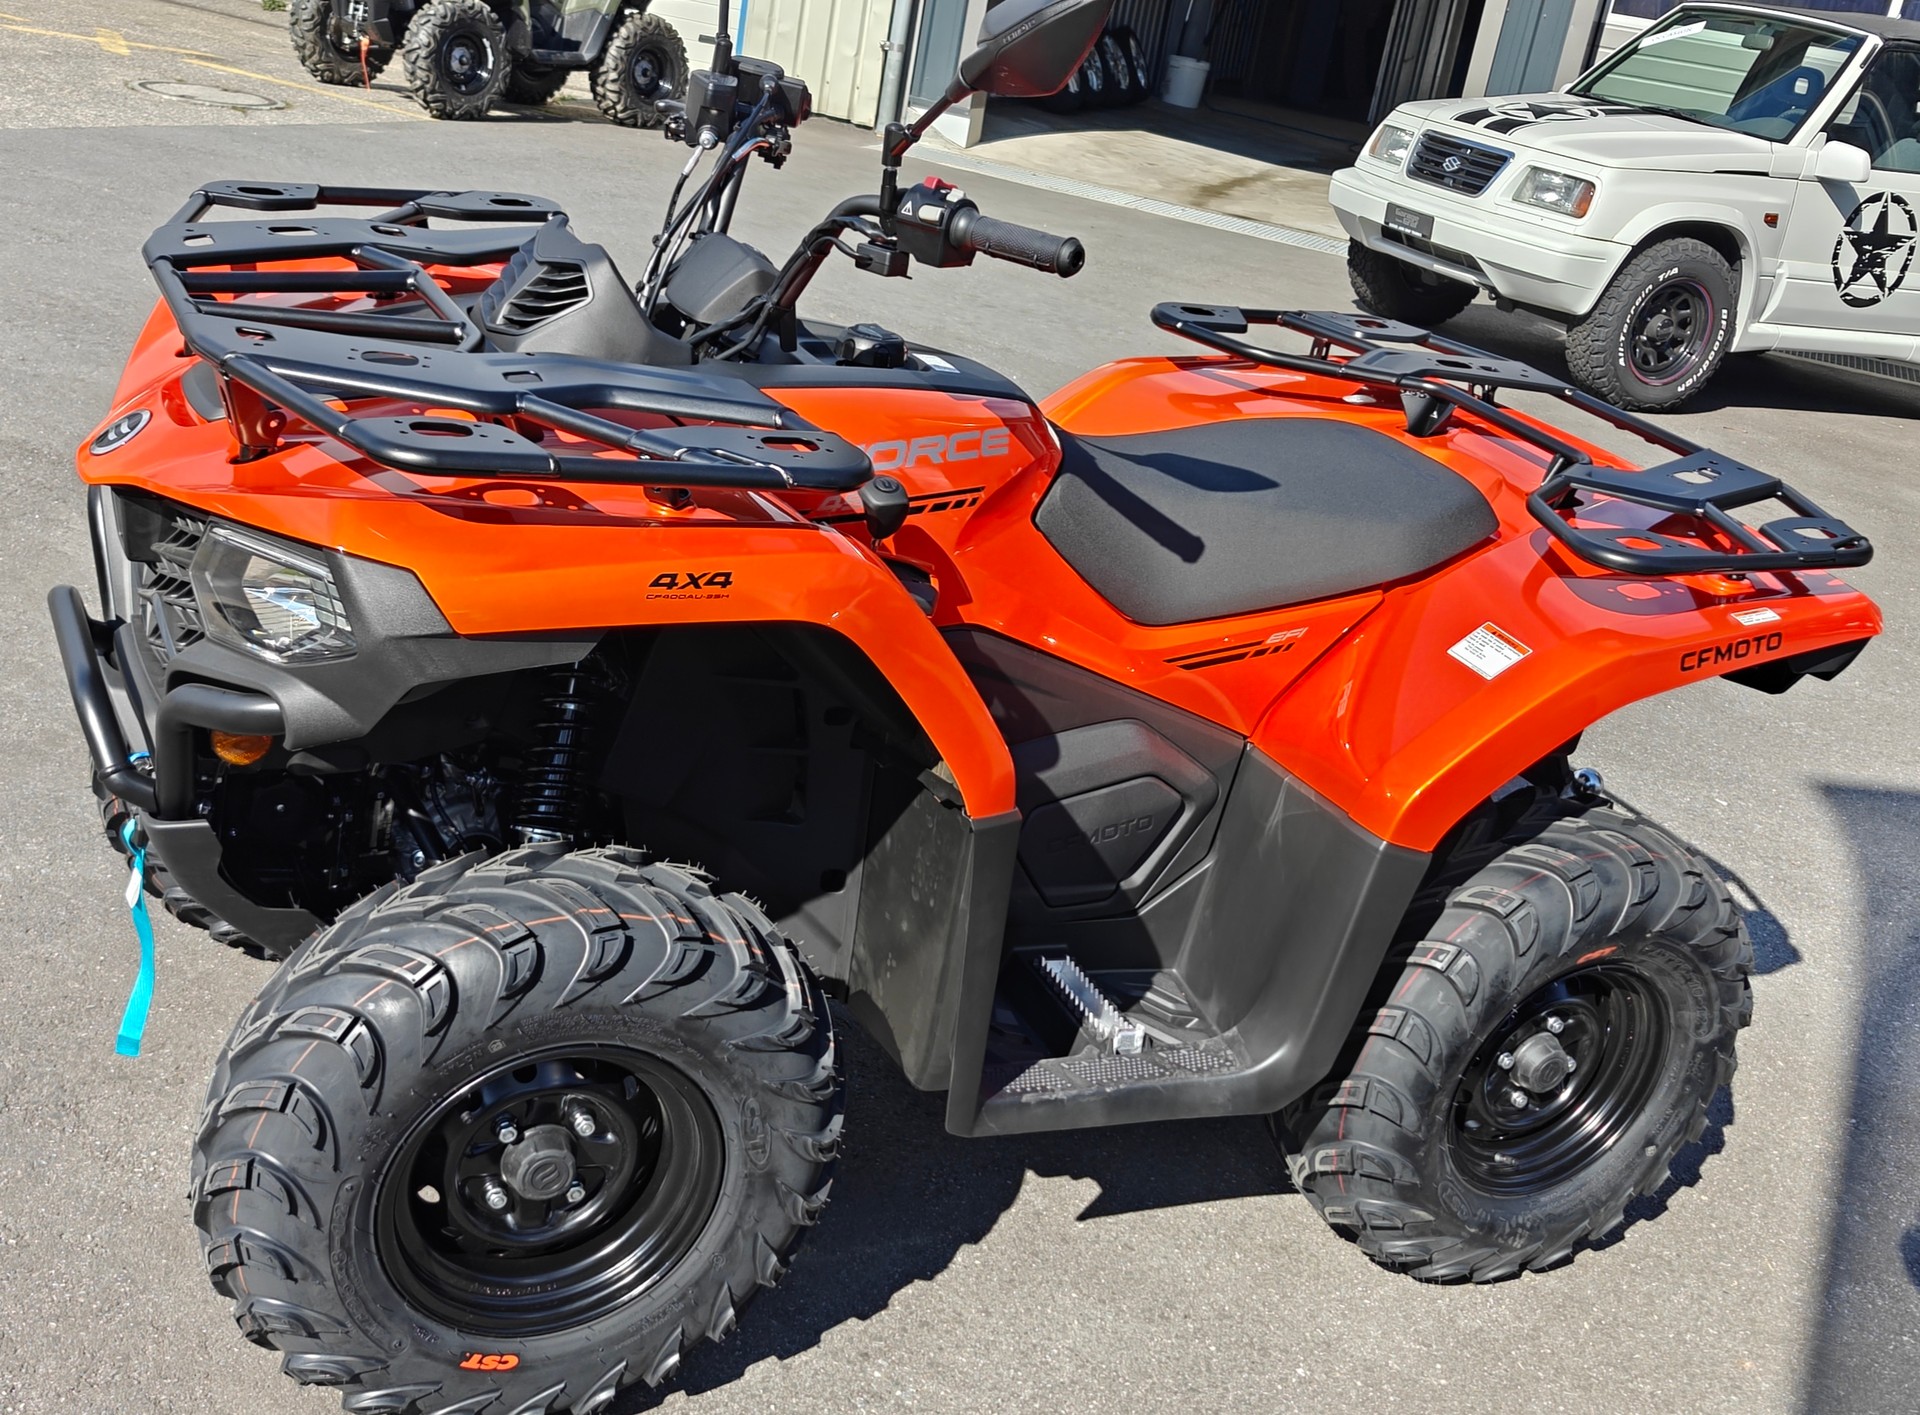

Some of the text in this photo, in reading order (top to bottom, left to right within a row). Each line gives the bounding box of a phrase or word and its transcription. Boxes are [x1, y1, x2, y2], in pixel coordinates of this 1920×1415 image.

[1658, 267, 1679, 282] T/A
[1677, 308, 1729, 392] BFGoodrich
[858, 426, 1010, 472] ORCE
[1265, 627, 1309, 644] EFI
[1680, 632, 1783, 672] CFMOTO
[460, 1352, 519, 1371] CST
